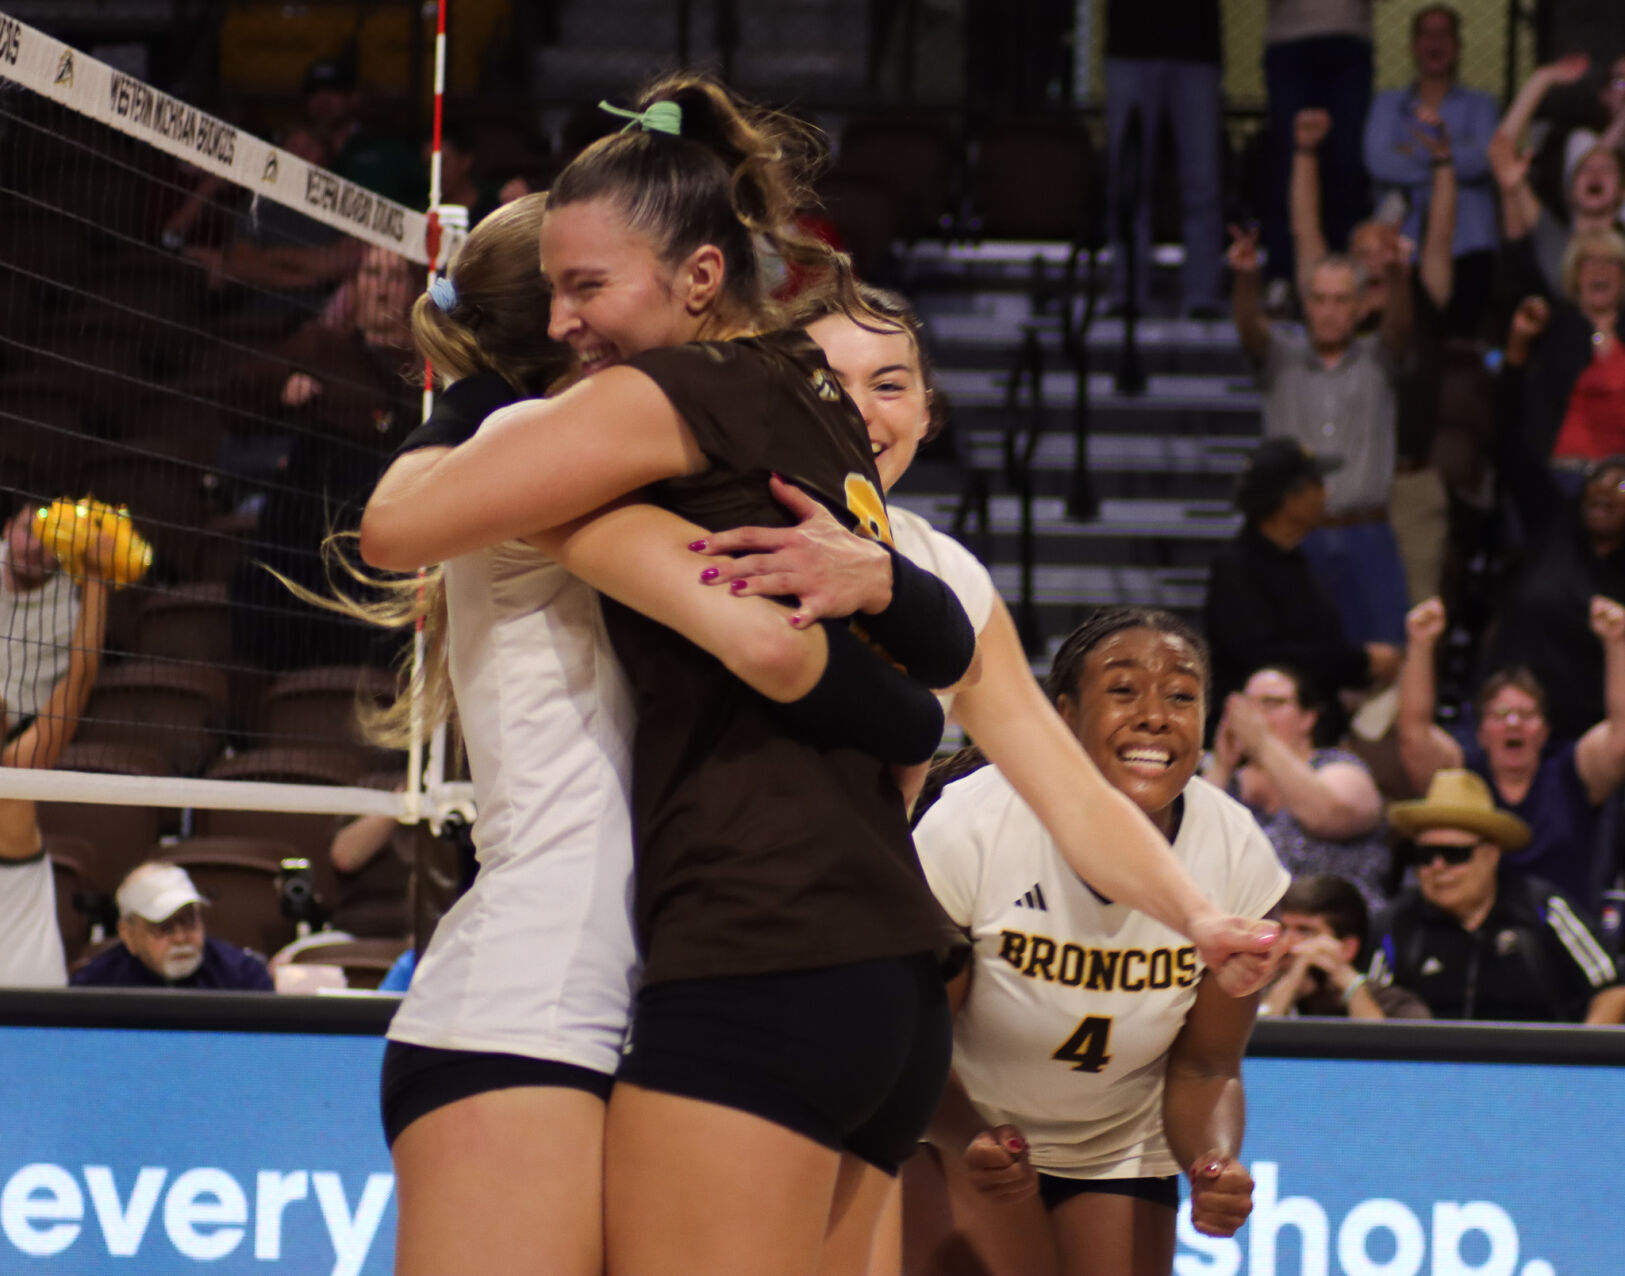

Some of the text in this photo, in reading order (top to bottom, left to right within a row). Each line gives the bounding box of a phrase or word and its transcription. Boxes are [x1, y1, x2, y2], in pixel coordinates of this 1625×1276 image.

[997, 928, 1198, 993] BRONCOS
[1051, 1013, 1113, 1074] 4
[1, 1162, 396, 1276] every
